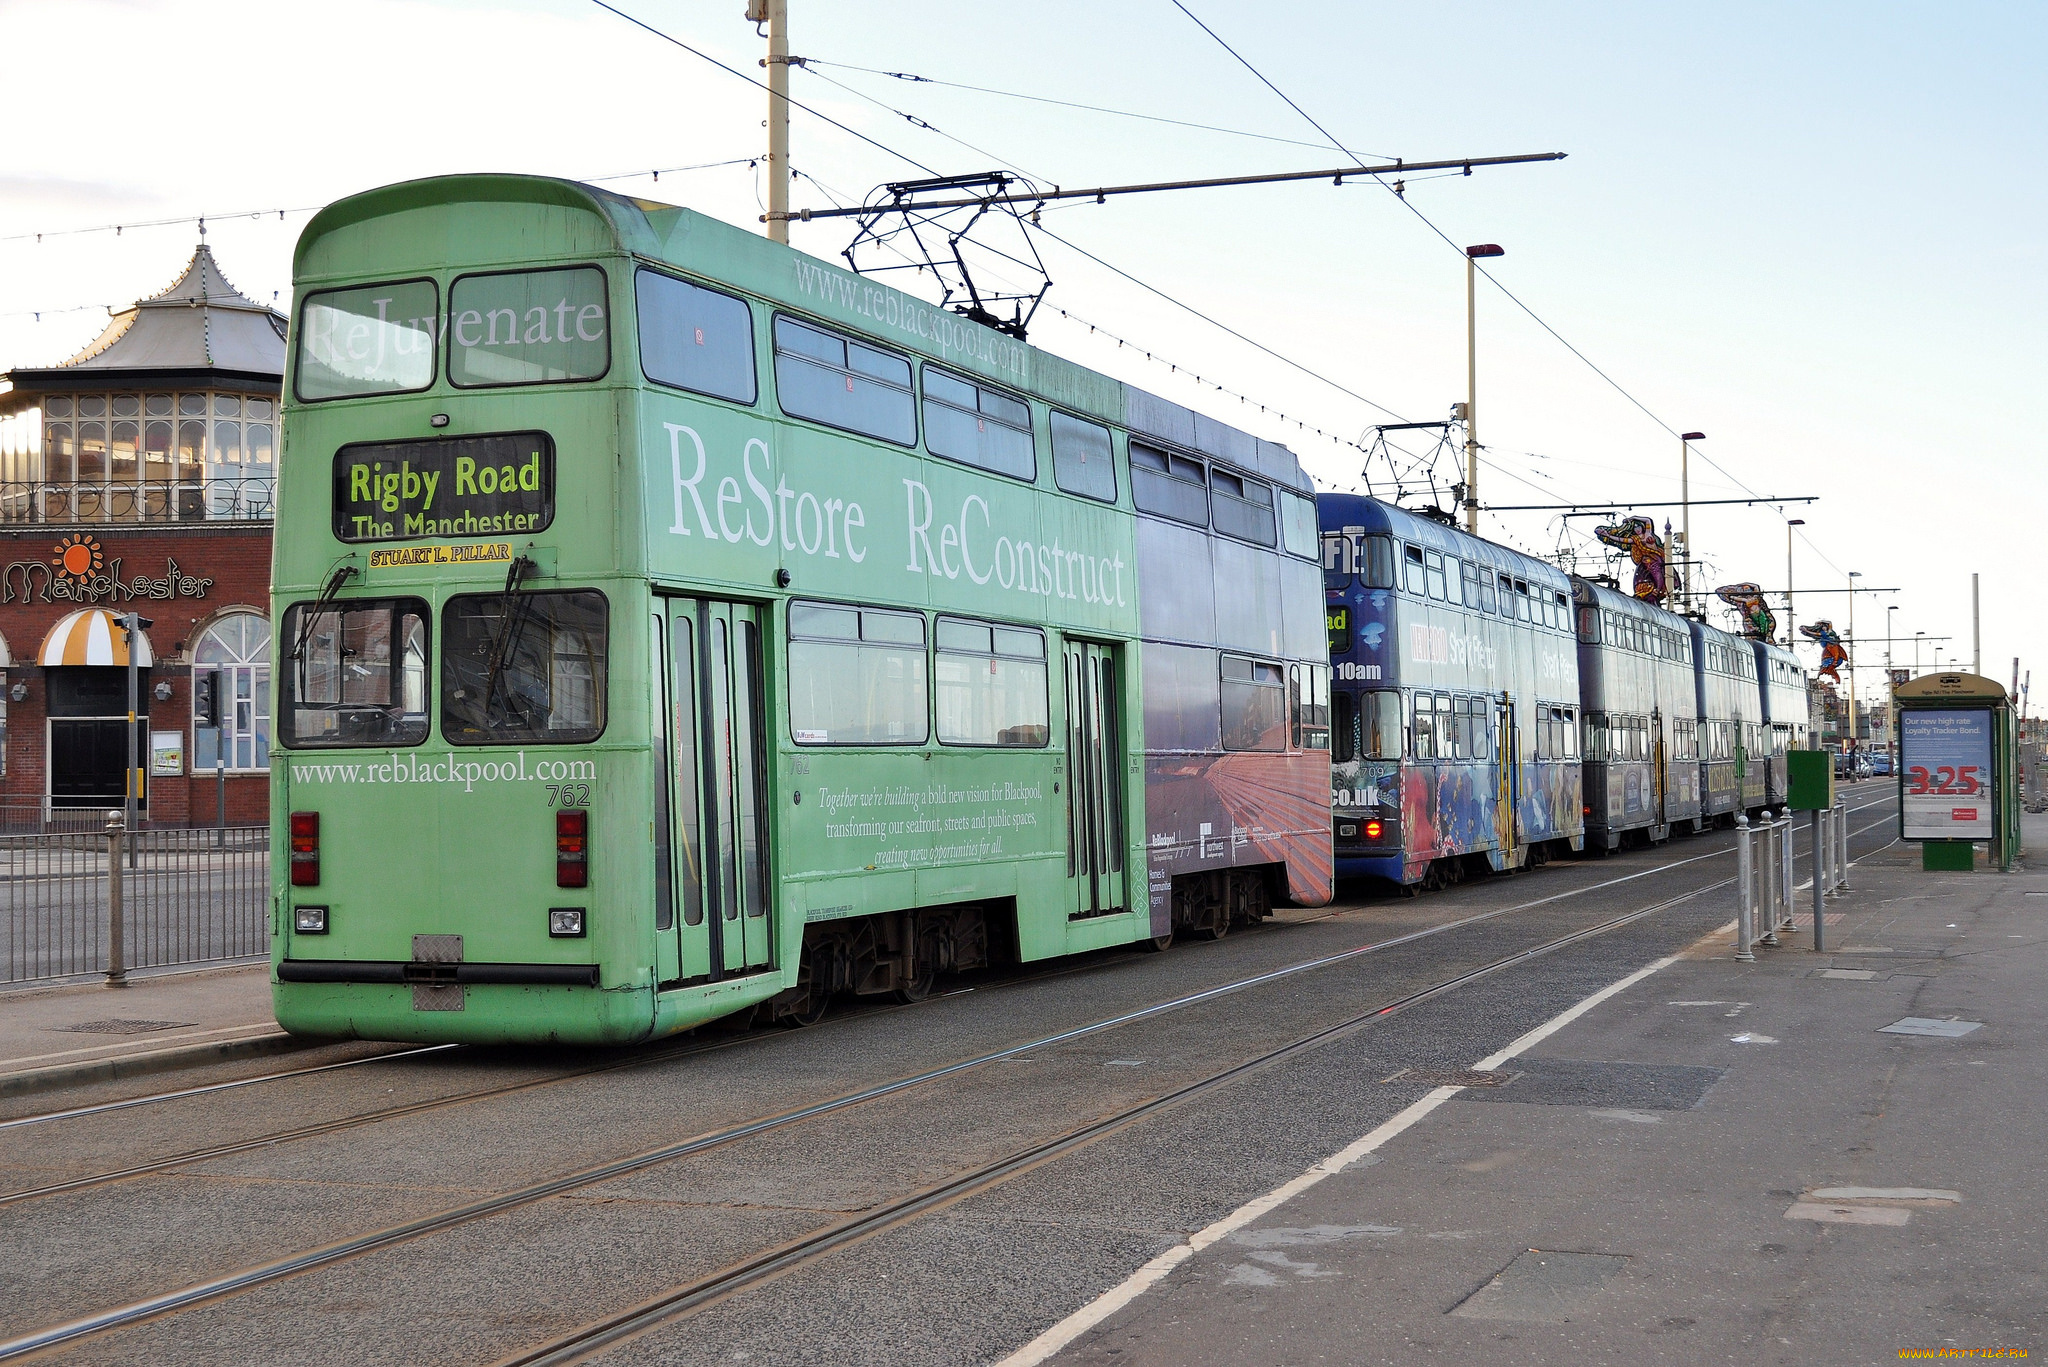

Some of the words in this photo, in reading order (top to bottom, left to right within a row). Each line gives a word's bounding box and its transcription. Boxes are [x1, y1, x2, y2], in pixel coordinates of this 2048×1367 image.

[793, 257, 1026, 377] www.reblackpool.com
[303, 297, 604, 373] ReJuvenate
[351, 461, 440, 513] Rigby
[457, 452, 539, 496] Road
[664, 422, 866, 563] ReStore
[352, 516, 393, 538] The
[404, 510, 539, 537] Manchester
[371, 548, 431, 567] STUART
[434, 548, 448, 564] L.
[451, 544, 510, 563] PILLAR
[903, 478, 1125, 608] ReConstruct
[3, 557, 213, 603] Manchester
[1337, 662, 1382, 680] 10am
[1905, 727, 1931, 735] Loyalty
[1938, 718, 1954, 727] high
[292, 750, 597, 792] www.reblackpool.com
[790, 755, 810, 775] 762
[1360, 767, 1384, 778] 709
[545, 784, 591, 807] 762
[819, 786, 859, 816] Together
[860, 785, 883, 807] we're
[884, 785, 919, 811] building
[921, 794, 927, 805] a
[928, 784, 947, 804] bold
[948, 791, 965, 803] new
[966, 785, 990, 803] vision
[991, 783, 1003, 801] for
[1004, 781, 1042, 805] Blackpool,
[826, 816, 886, 842] transforming
[888, 820, 904, 835] our
[905, 813, 943, 836] seafront,
[944, 817, 970, 833] streets
[971, 809, 987, 829] and
[988, 809, 1011, 834] public
[1012, 811, 1038, 832] spaces,
[874, 844, 908, 869] creating
[910, 849, 928, 862] new
[929, 840, 979, 867] opportunities
[978, 837, 992, 862] for
[992, 836, 1003, 853] all.
[1149, 881, 1171, 892] Communities
[1150, 895, 1163, 907] Agency
